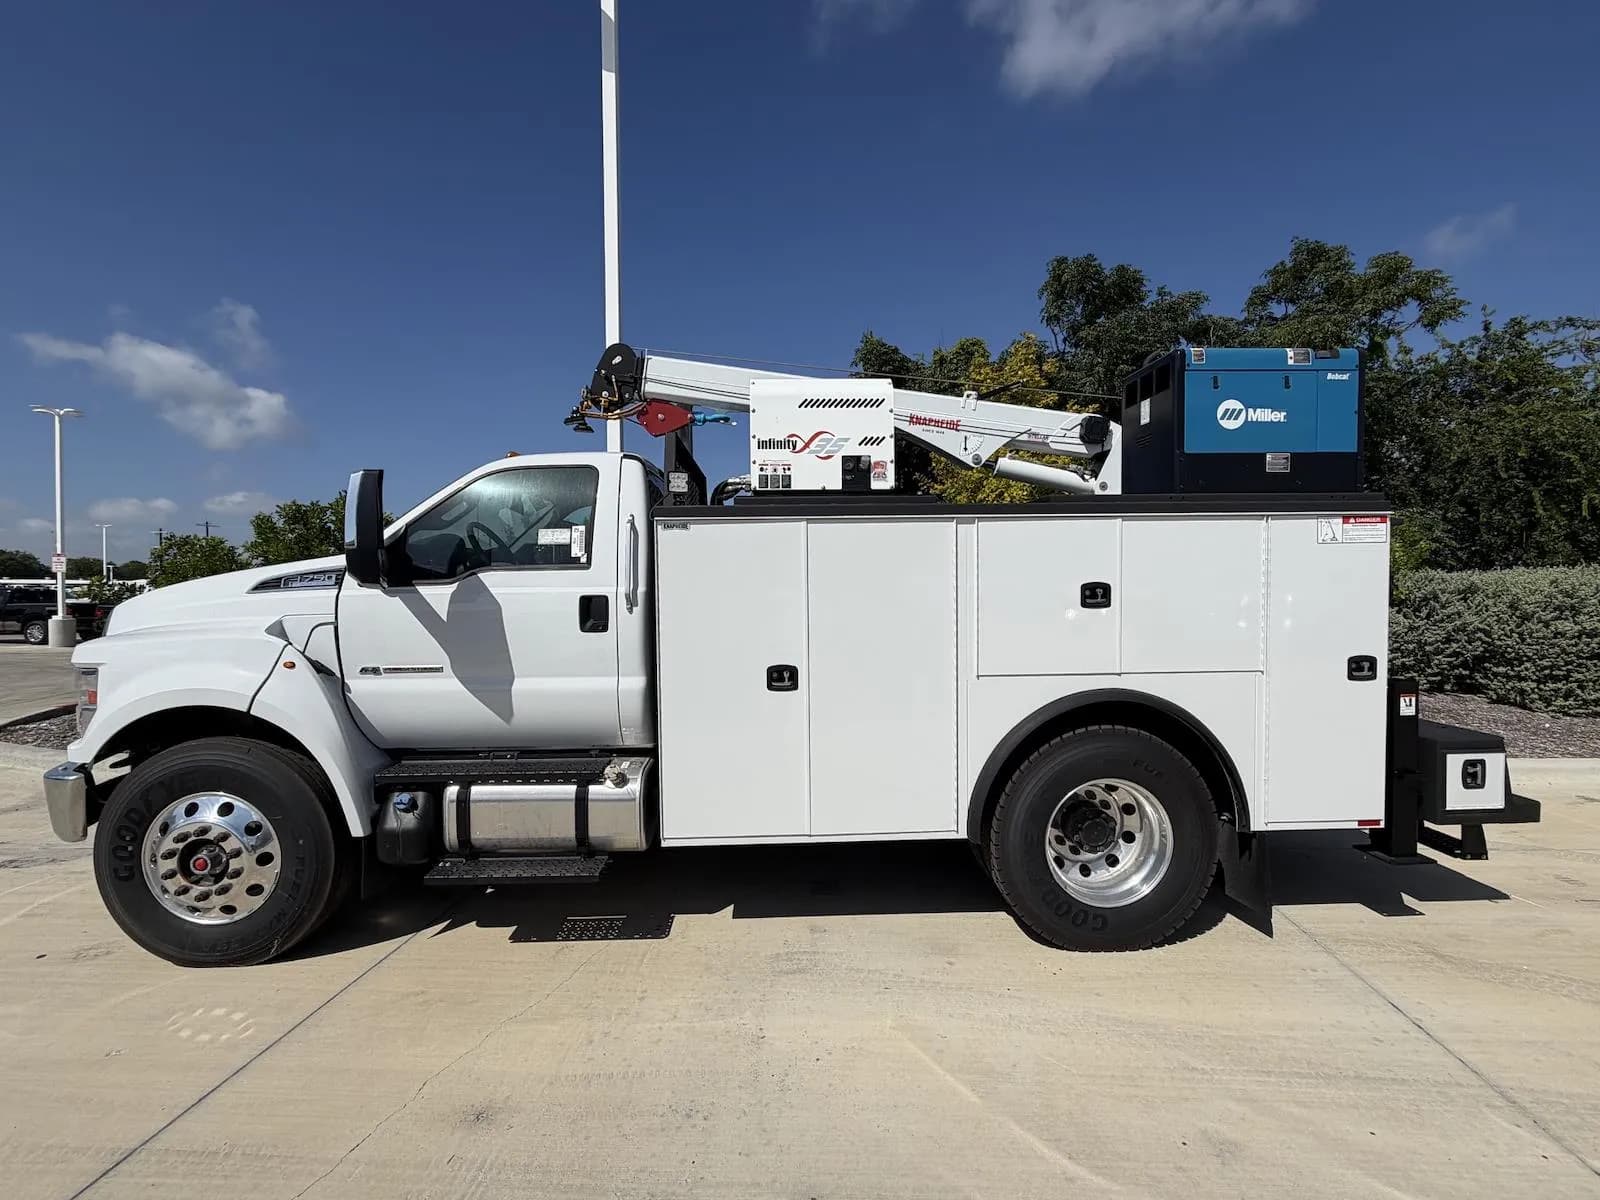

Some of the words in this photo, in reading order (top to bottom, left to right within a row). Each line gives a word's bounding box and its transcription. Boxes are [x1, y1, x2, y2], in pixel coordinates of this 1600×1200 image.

[1326, 372, 1350, 381] Bobcat
[1246, 408, 1287, 422] Miller
[757, 437, 797, 451] infinity
